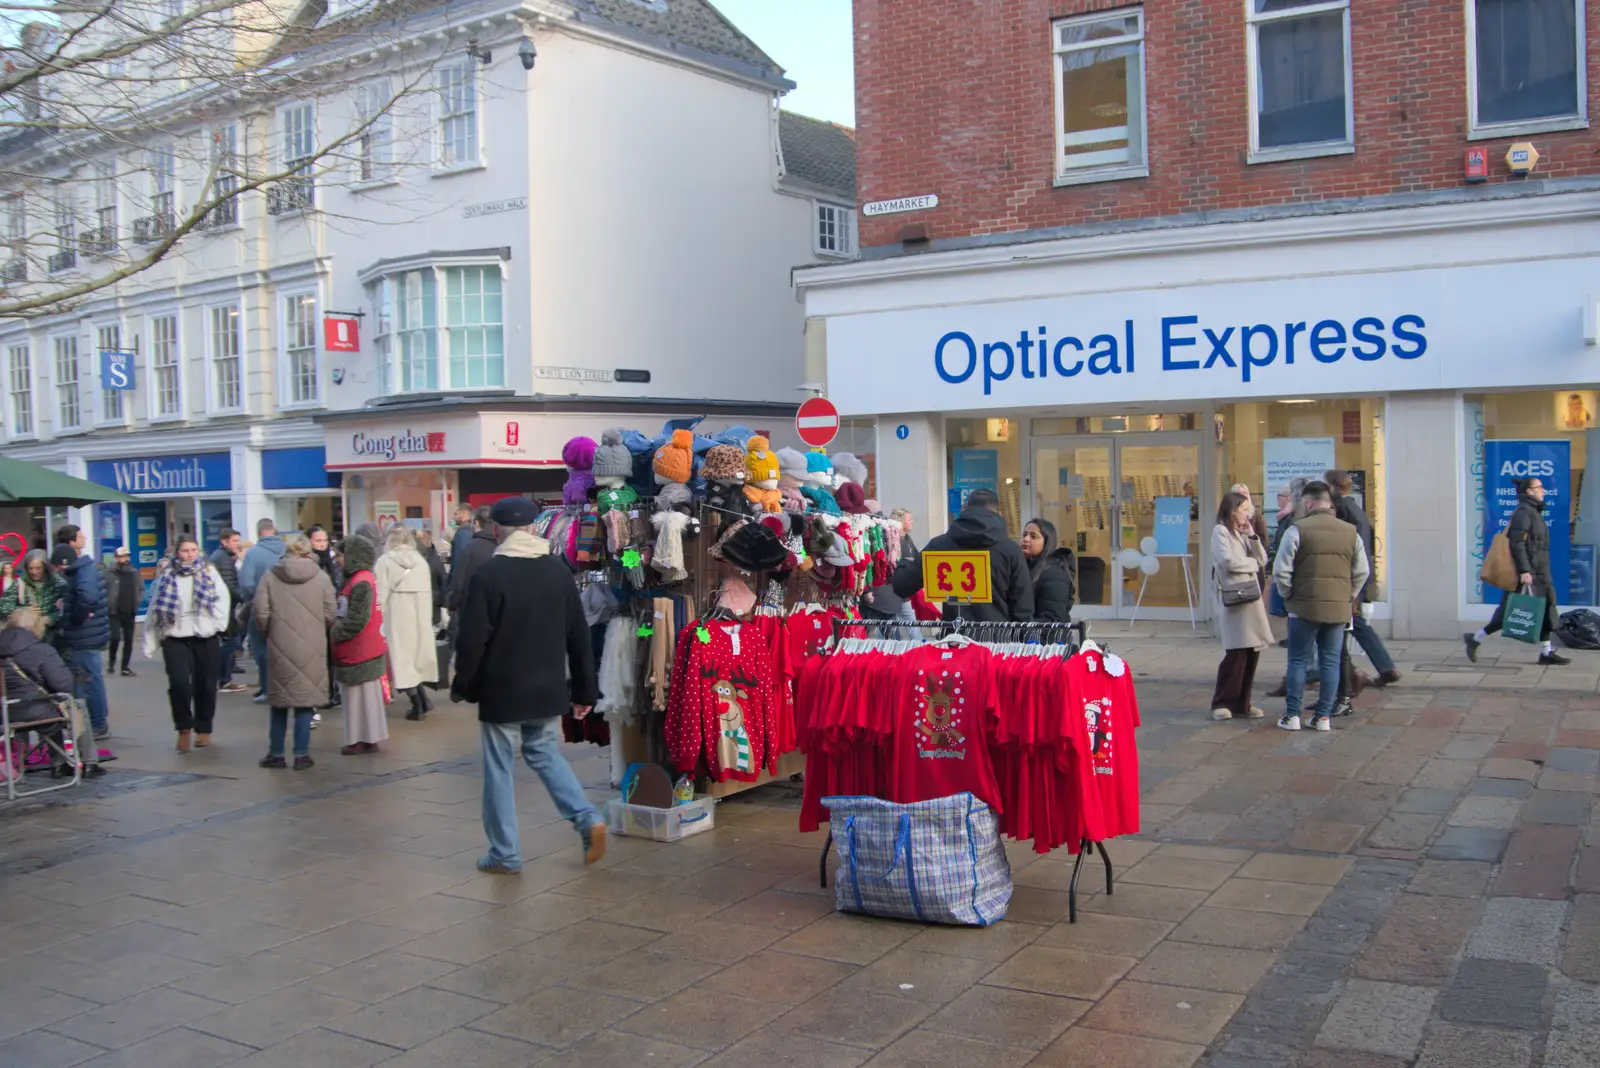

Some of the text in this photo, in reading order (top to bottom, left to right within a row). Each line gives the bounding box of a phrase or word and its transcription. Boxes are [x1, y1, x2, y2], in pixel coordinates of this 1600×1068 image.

[869, 196, 930, 213] HAYMARKET
[934, 314, 1428, 395] Optical Express
[110, 362, 128, 387] S
[538, 368, 562, 379] WHITE
[564, 369, 581, 380] LION
[584, 370, 609, 381] STREET
[398, 428, 427, 454] cha
[112, 457, 207, 491] WHSmith
[1500, 459, 1555, 477] ACES
[1495, 487, 1517, 496] NHS
